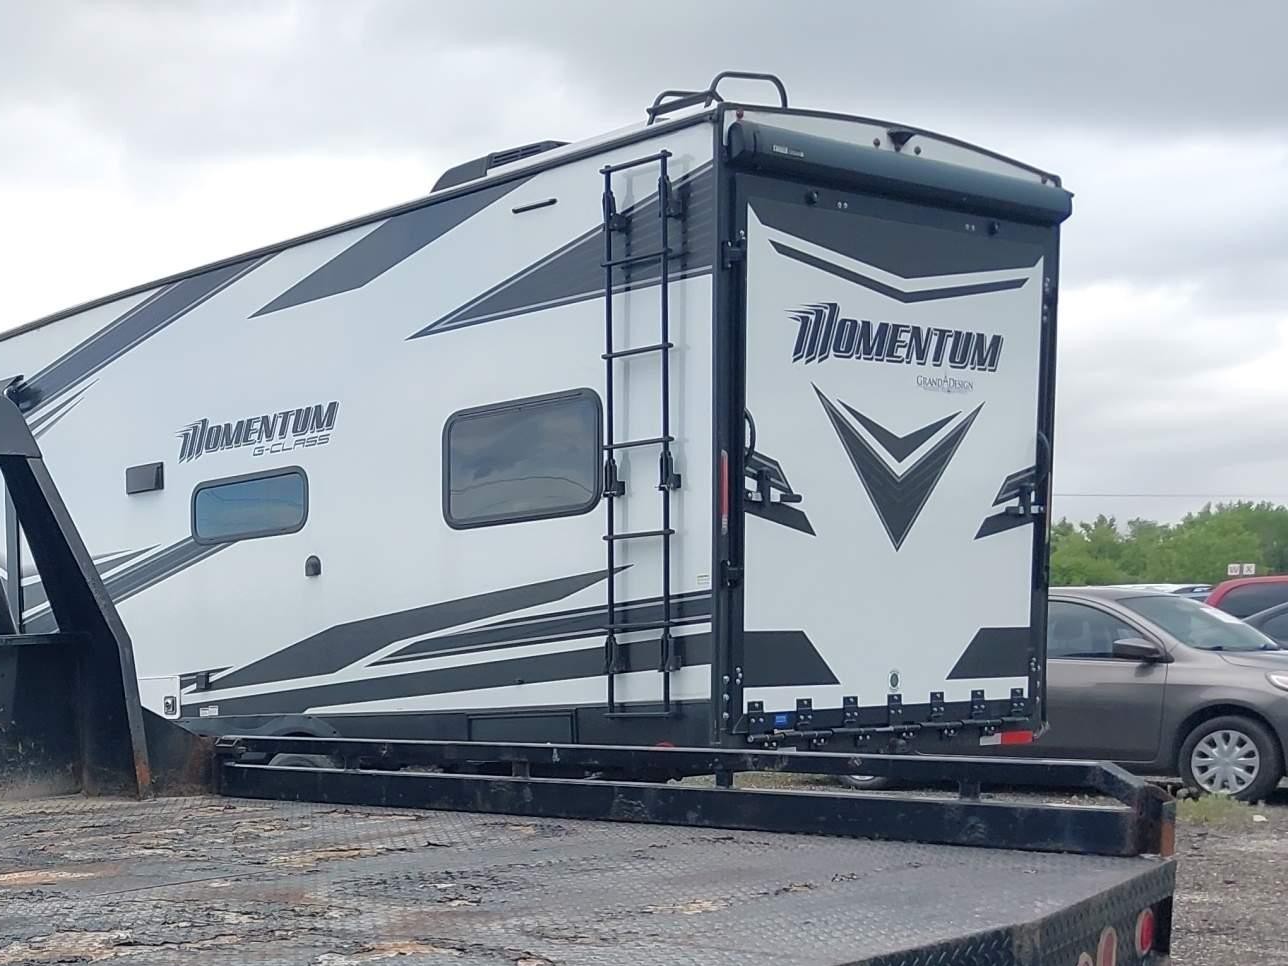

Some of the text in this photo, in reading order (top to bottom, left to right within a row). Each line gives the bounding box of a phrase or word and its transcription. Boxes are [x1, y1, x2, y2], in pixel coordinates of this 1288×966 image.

[784, 302, 1005, 373] MOMENTUM
[916, 375, 943, 388] GRAND
[174, 400, 340, 464] MOMENTUM
[252, 433, 331, 456] G-CLASS
